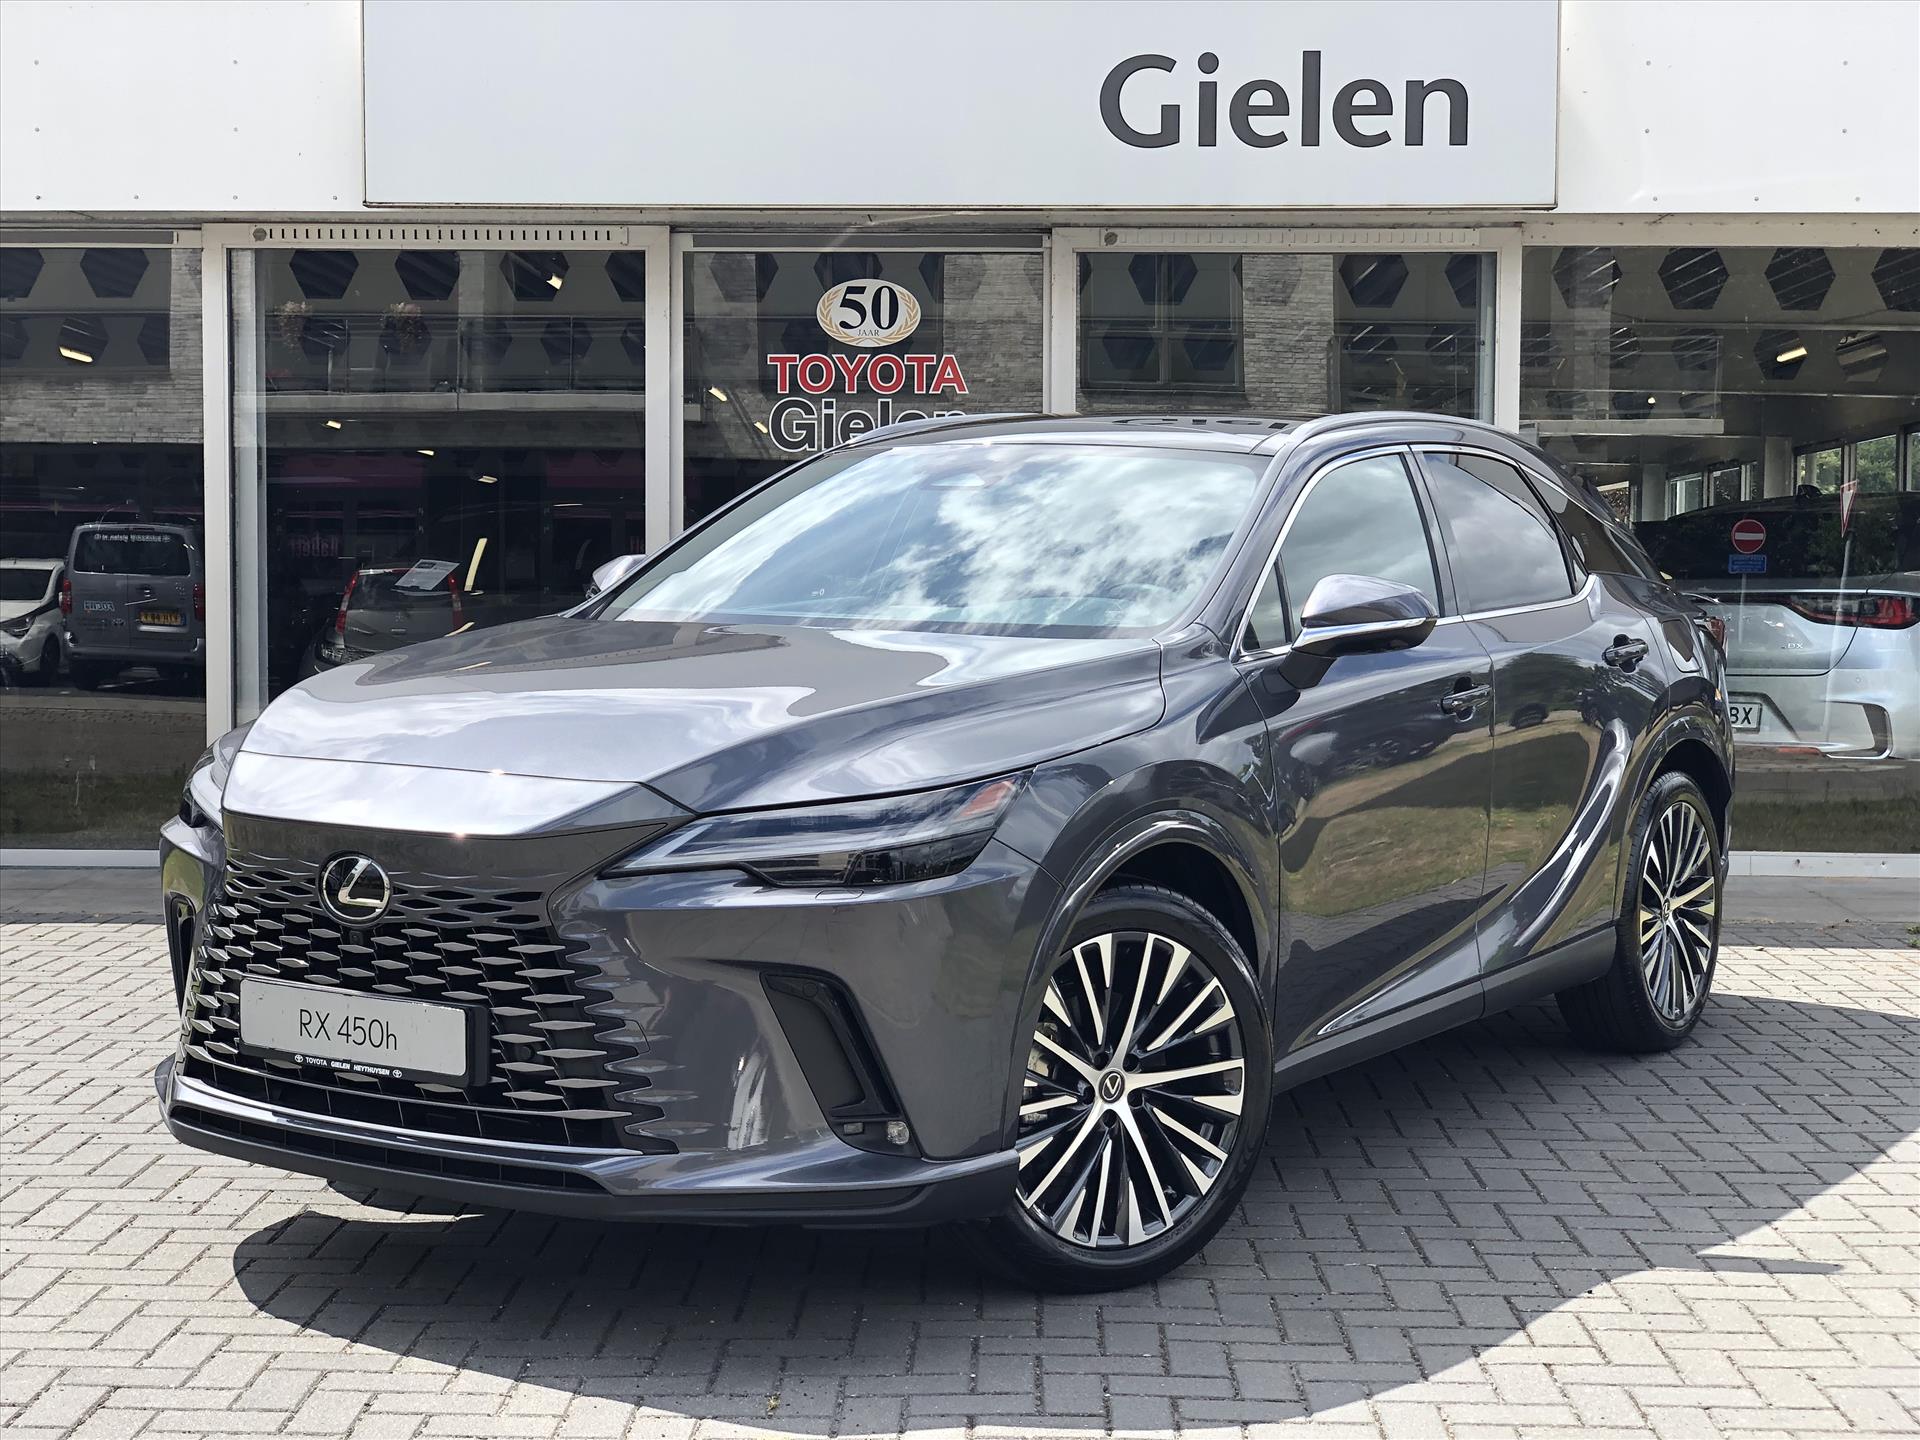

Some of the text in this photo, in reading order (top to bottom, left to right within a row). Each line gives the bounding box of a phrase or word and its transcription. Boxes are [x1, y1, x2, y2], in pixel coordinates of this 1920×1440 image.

[1100, 51, 1468, 148] Gielen
[839, 285, 899, 330] 50
[857, 328, 880, 337] JAAR
[767, 354, 969, 394] TOYOTA
[300, 1009, 397, 1051] RX 450h
[305, 1056, 390, 1076] TOYOTA GIELEN HEYTHUYSEN
